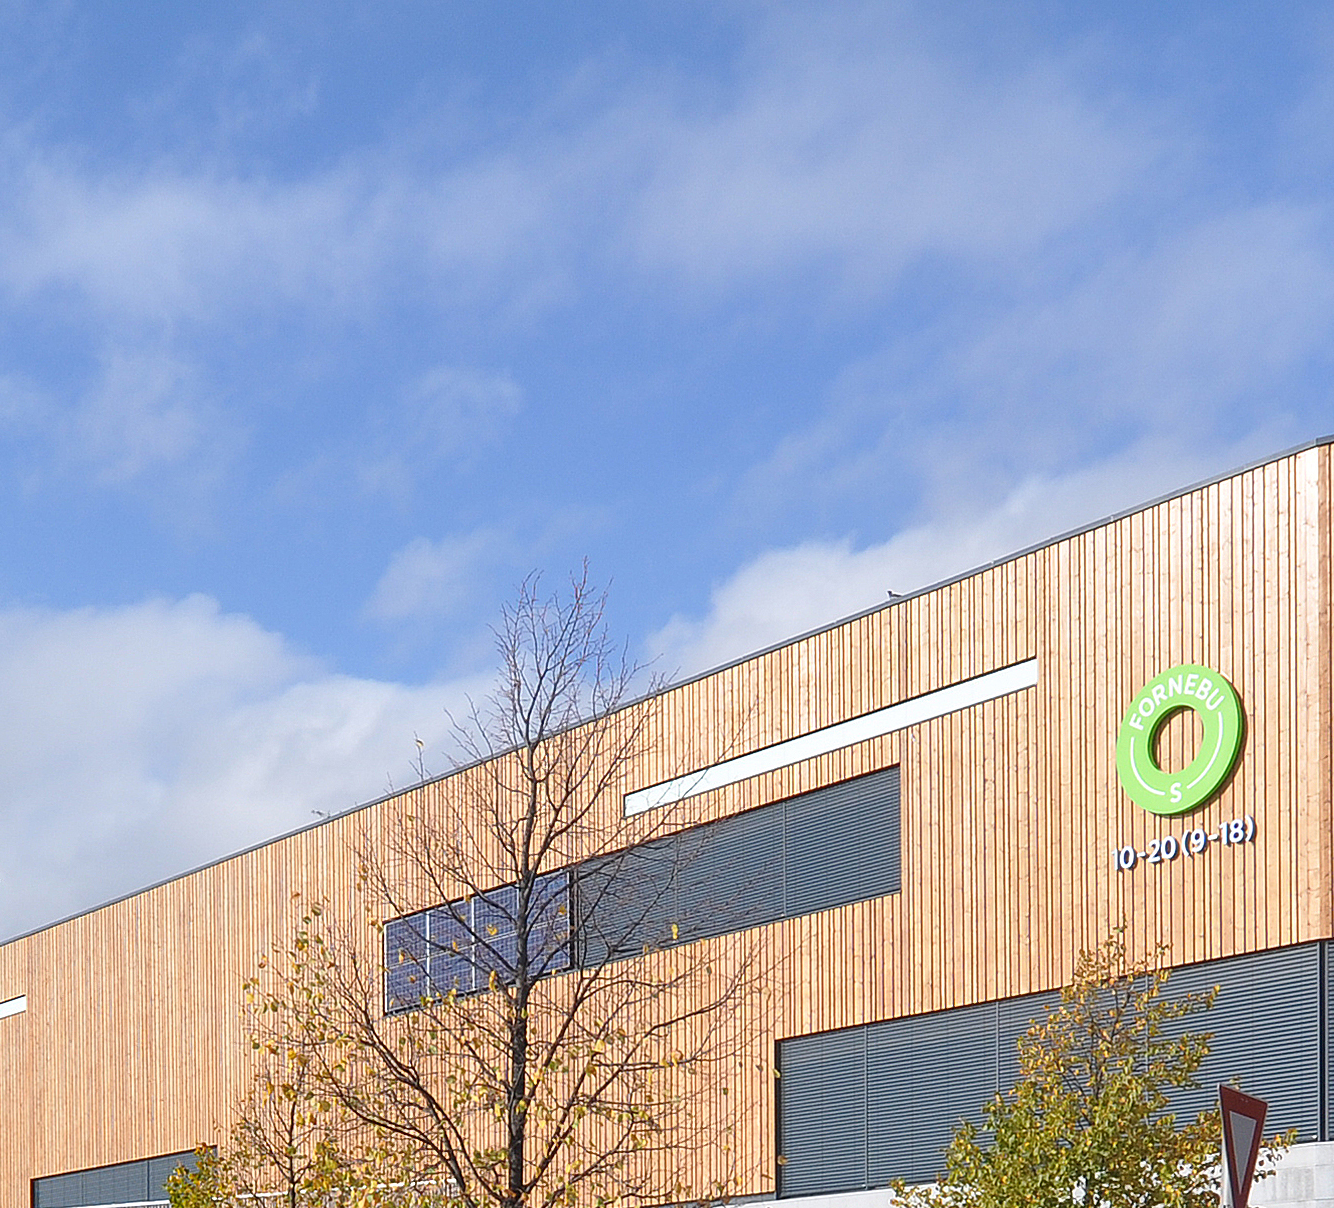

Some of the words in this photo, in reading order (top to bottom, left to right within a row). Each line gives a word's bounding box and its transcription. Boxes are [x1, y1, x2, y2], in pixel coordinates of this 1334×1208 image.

[1129, 673, 1224, 730] FORNEBU
[1170, 782, 1183, 803] S
[1112, 836, 1177, 870] 10-20
[1181, 814, 1254, 857] (9-18)
